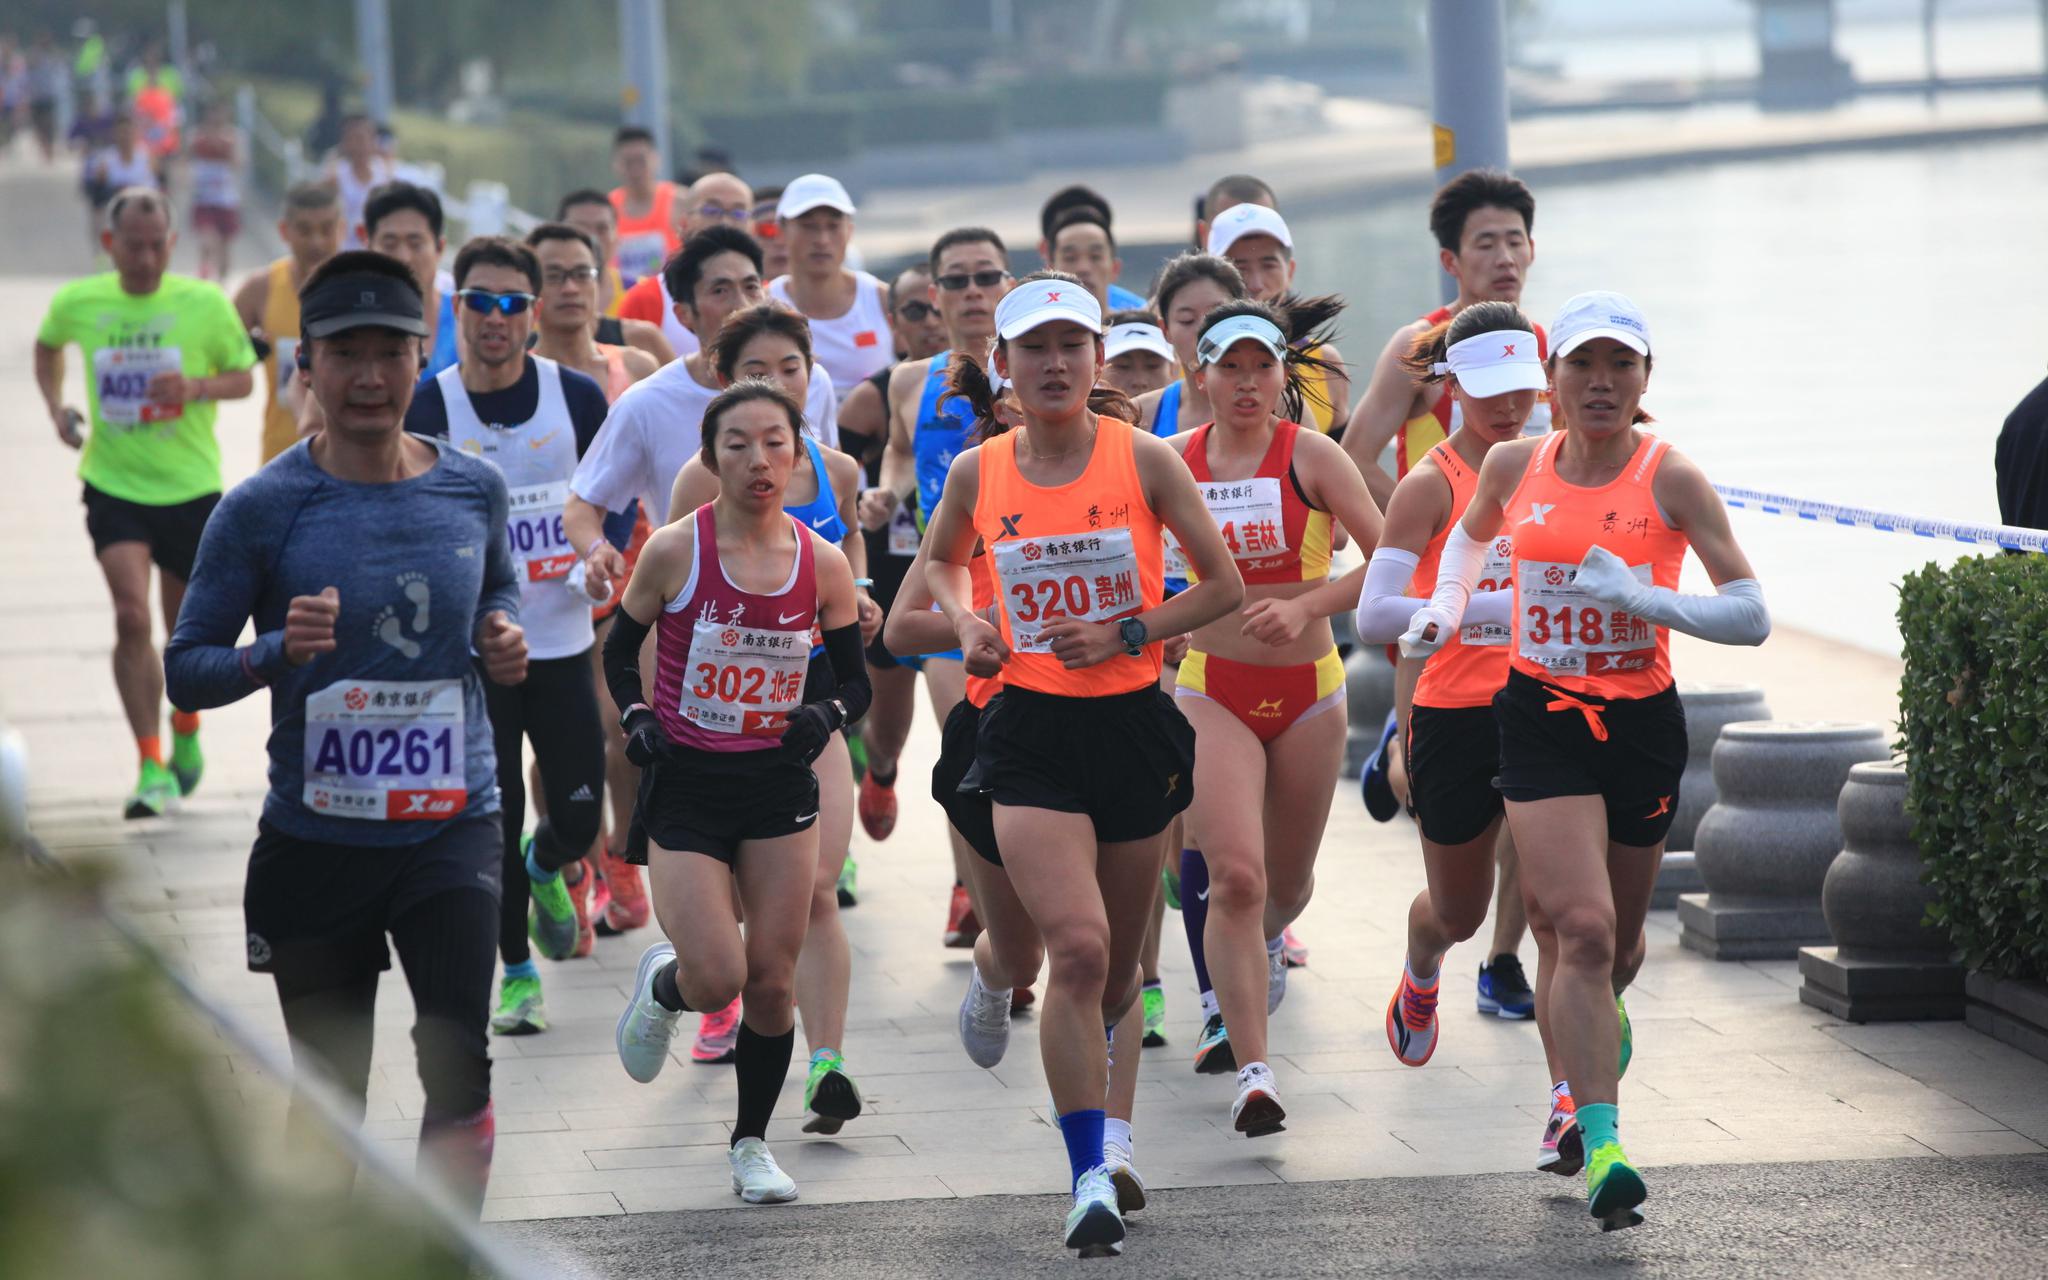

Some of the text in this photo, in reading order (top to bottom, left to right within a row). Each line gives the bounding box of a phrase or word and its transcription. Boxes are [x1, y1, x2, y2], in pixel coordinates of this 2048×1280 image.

[1206, 485, 1253, 501] 南京银行
[1045, 538, 1101, 557] 南京银行
[1221, 519, 1279, 554] 4 吉林
[1011, 569, 1135, 623] 320 贵州
[699, 600, 746, 626] 北京
[1527, 604, 1649, 646] 318 贵州
[742, 632, 793, 650] 南京银行
[693, 662, 803, 705] 302 北京
[372, 691, 433, 707] 南京银行
[314, 727, 452, 776] A0261
